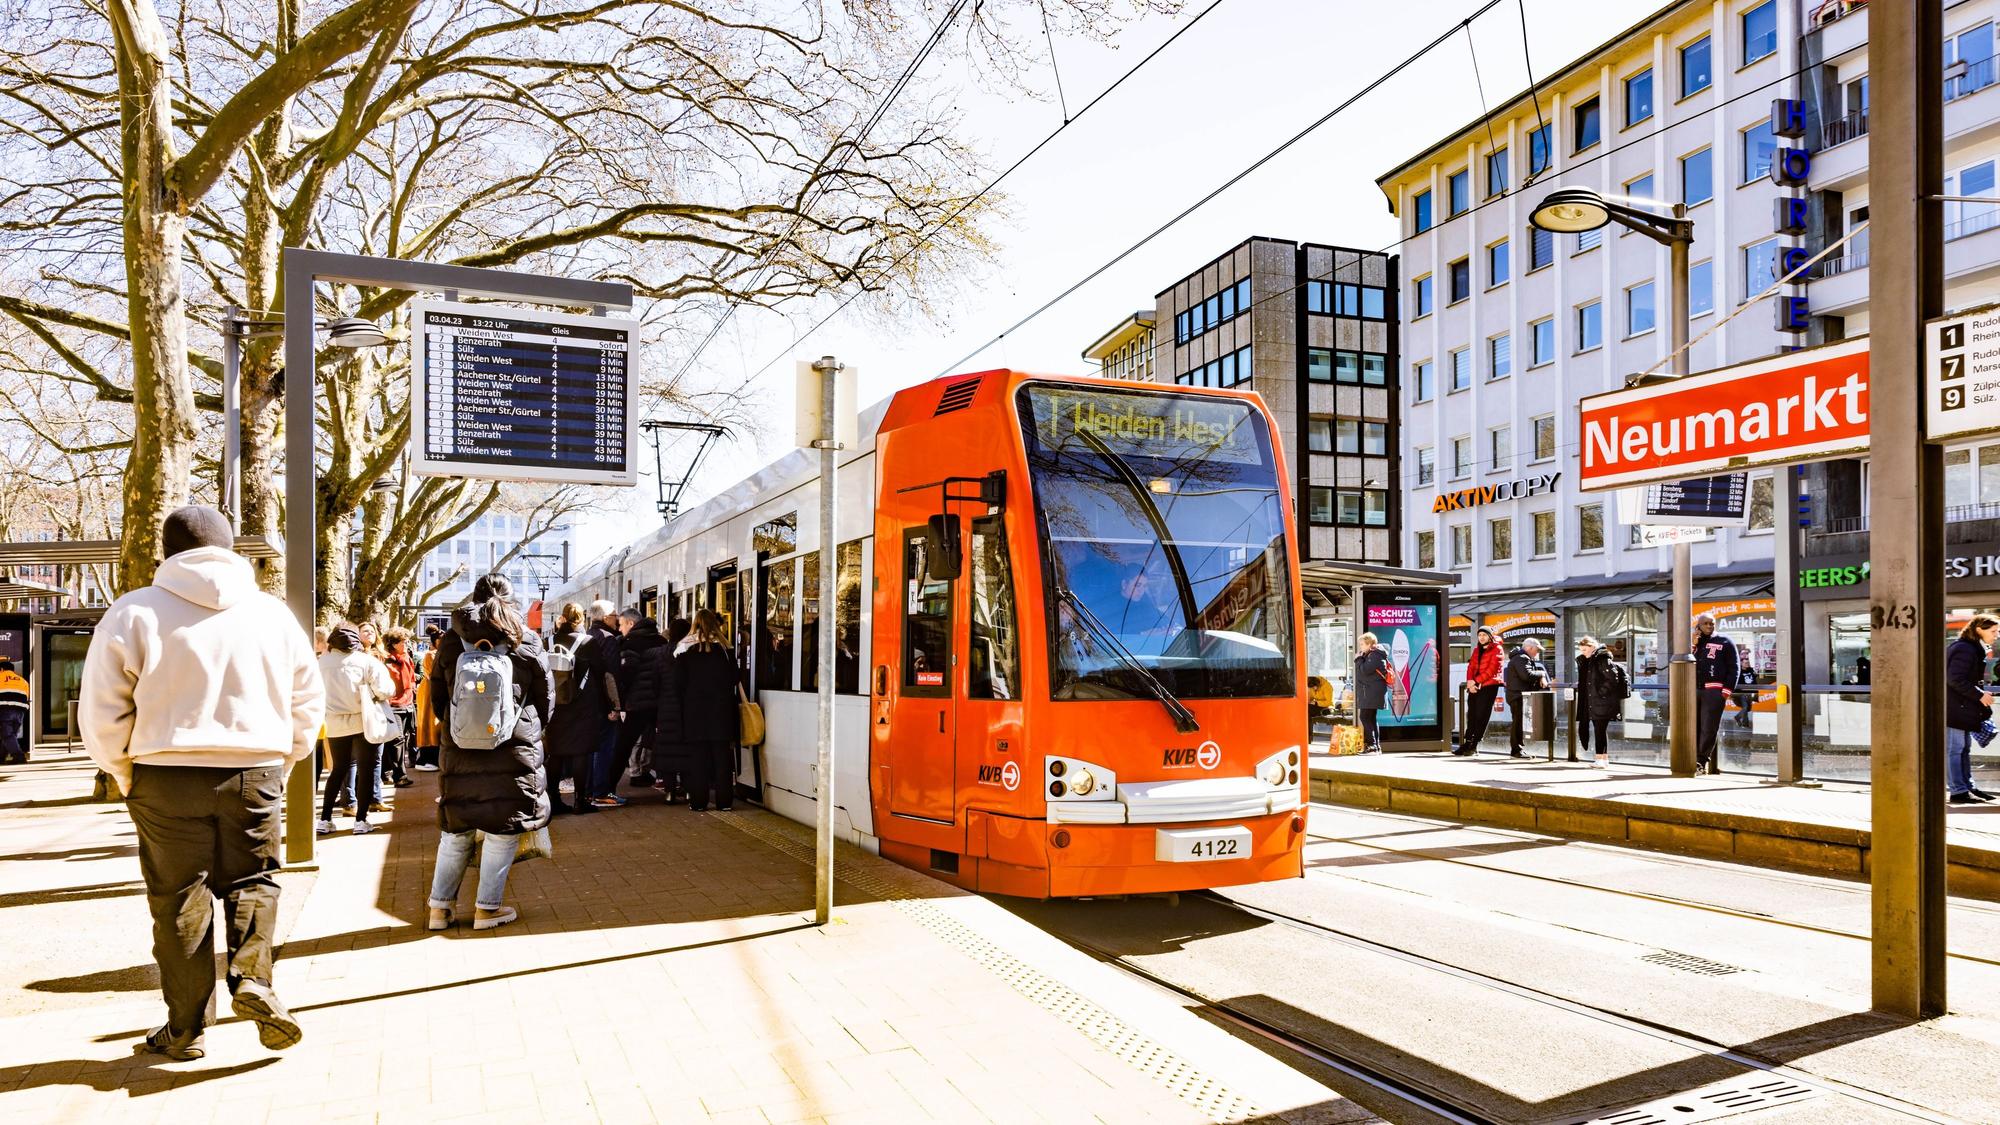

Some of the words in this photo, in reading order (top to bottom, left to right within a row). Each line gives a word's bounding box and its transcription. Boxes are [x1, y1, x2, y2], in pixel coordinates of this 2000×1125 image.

[430, 316, 462, 324] 03.04.23
[473, 320, 493, 328] 13:22
[458, 328, 490, 337] Weiden
[492, 330, 513, 339] West
[1946, 328, 1956, 346] 1
[458, 337, 501, 347] Benzelrath
[458, 345, 474, 353] Sülz
[458, 354, 490, 362] Weiden
[492, 356, 513, 364] West
[458, 362, 474, 370] Sülz
[1946, 358, 1959, 376] 7
[458, 370, 496, 380] Aachener
[499, 374, 541, 384] Str./Gürtel
[458, 379, 490, 388] Weiden
[492, 381, 513, 390] West
[458, 387, 501, 398] Benzelrath
[1946, 389, 1960, 408] 9
[458, 396, 490, 404] Weiden
[492, 398, 513, 406] West
[458, 404, 496, 414] Aachener
[499, 407, 541, 417] Str./Gürtel
[458, 412, 474, 420] Sülz
[1075, 402, 1165, 440] Weiden
[1175, 410, 1234, 446] West
[1584, 372, 1867, 468] Neumarkt
[458, 421, 490, 430] Weiden
[492, 423, 513, 432] West
[458, 429, 501, 440] Benzelrath
[458, 437, 474, 446] Sülz
[458, 446, 490, 455] Weiden
[492, 448, 513, 457] West
[1432, 472, 1561, 513] AKTIVCOPY
[1975, 556, 2000, 576] H
[1870, 605, 1917, 630] 343
[1503, 627, 1536, 638] STUDENTEN
[1705, 643, 1723, 659] T
[1163, 749, 1196, 766] KVB
[979, 765, 1002, 782] KVB
[1192, 839, 1237, 857] 4122
